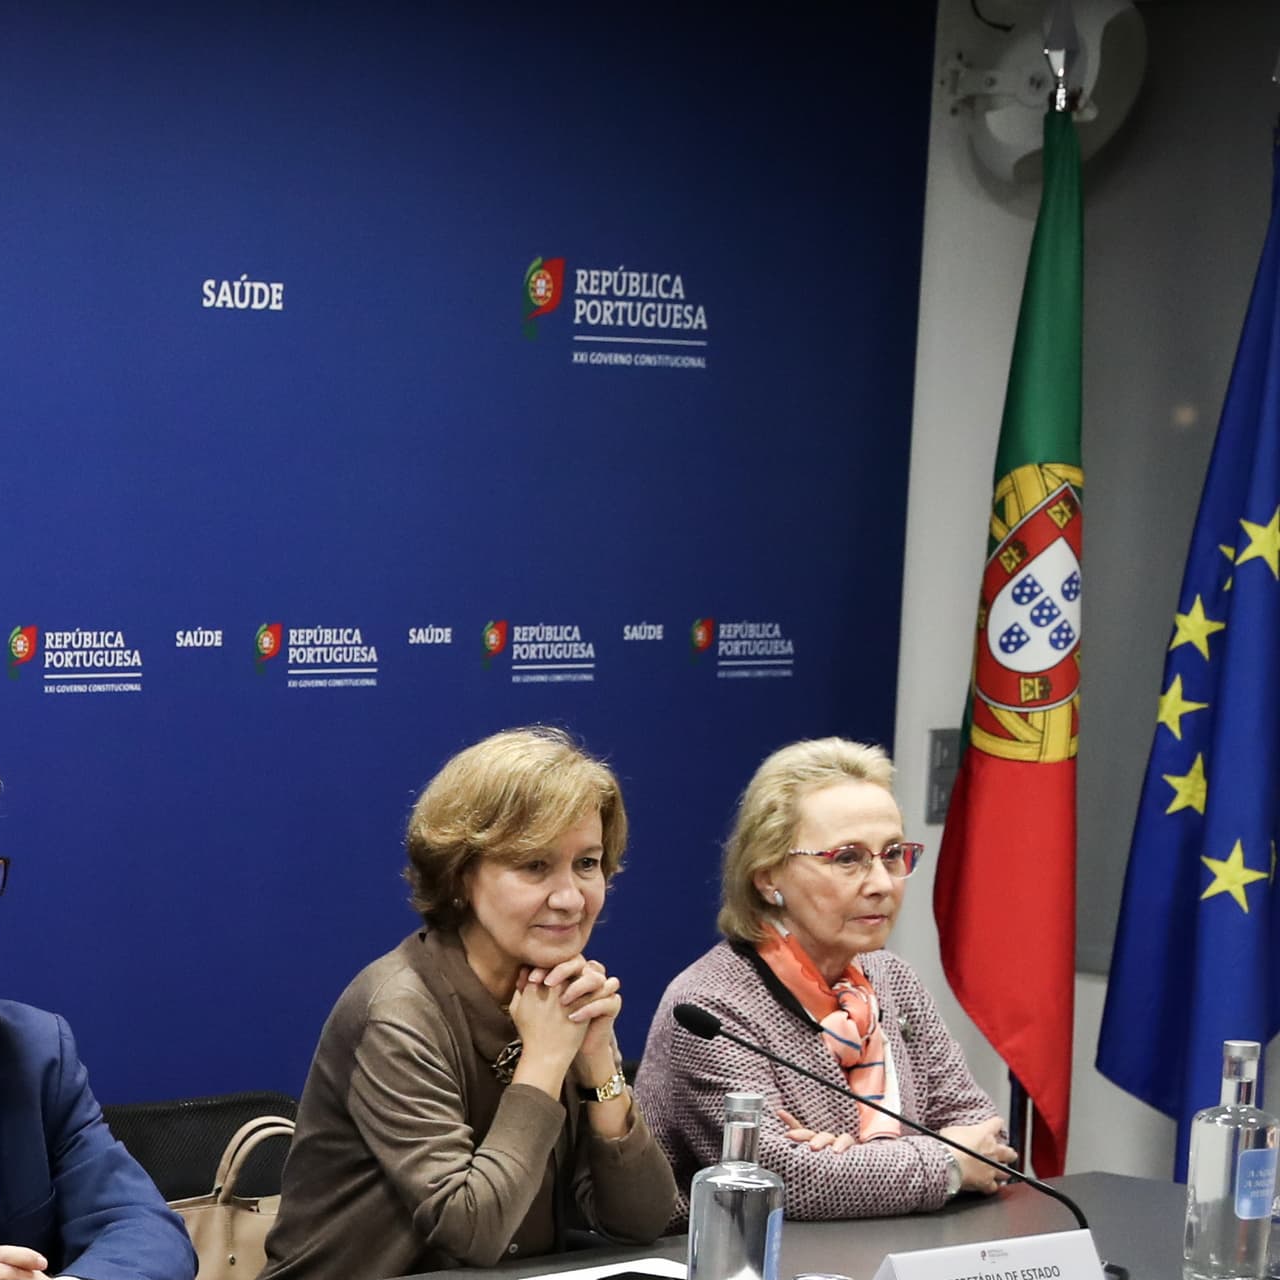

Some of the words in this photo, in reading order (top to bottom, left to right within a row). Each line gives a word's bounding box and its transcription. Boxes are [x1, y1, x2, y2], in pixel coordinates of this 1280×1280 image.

[203, 274, 283, 310] SAÚDE
[576, 266, 684, 299] REPÚBLICA
[574, 299, 707, 329] PORTUGUESA
[45, 628, 124, 648] REPÚBLICA
[176, 627, 222, 647] SAÚDE
[289, 626, 362, 645] REPÚBLICA
[409, 625, 451, 643] SAÚDE
[514, 623, 580, 642] REPÚBLICA
[624, 622, 663, 640] SAÚDE
[45, 650, 141, 668] PORTUGUESA
[288, 646, 377, 663] PORTUGUESA
[513, 643, 594, 659] PORTUGUESA
